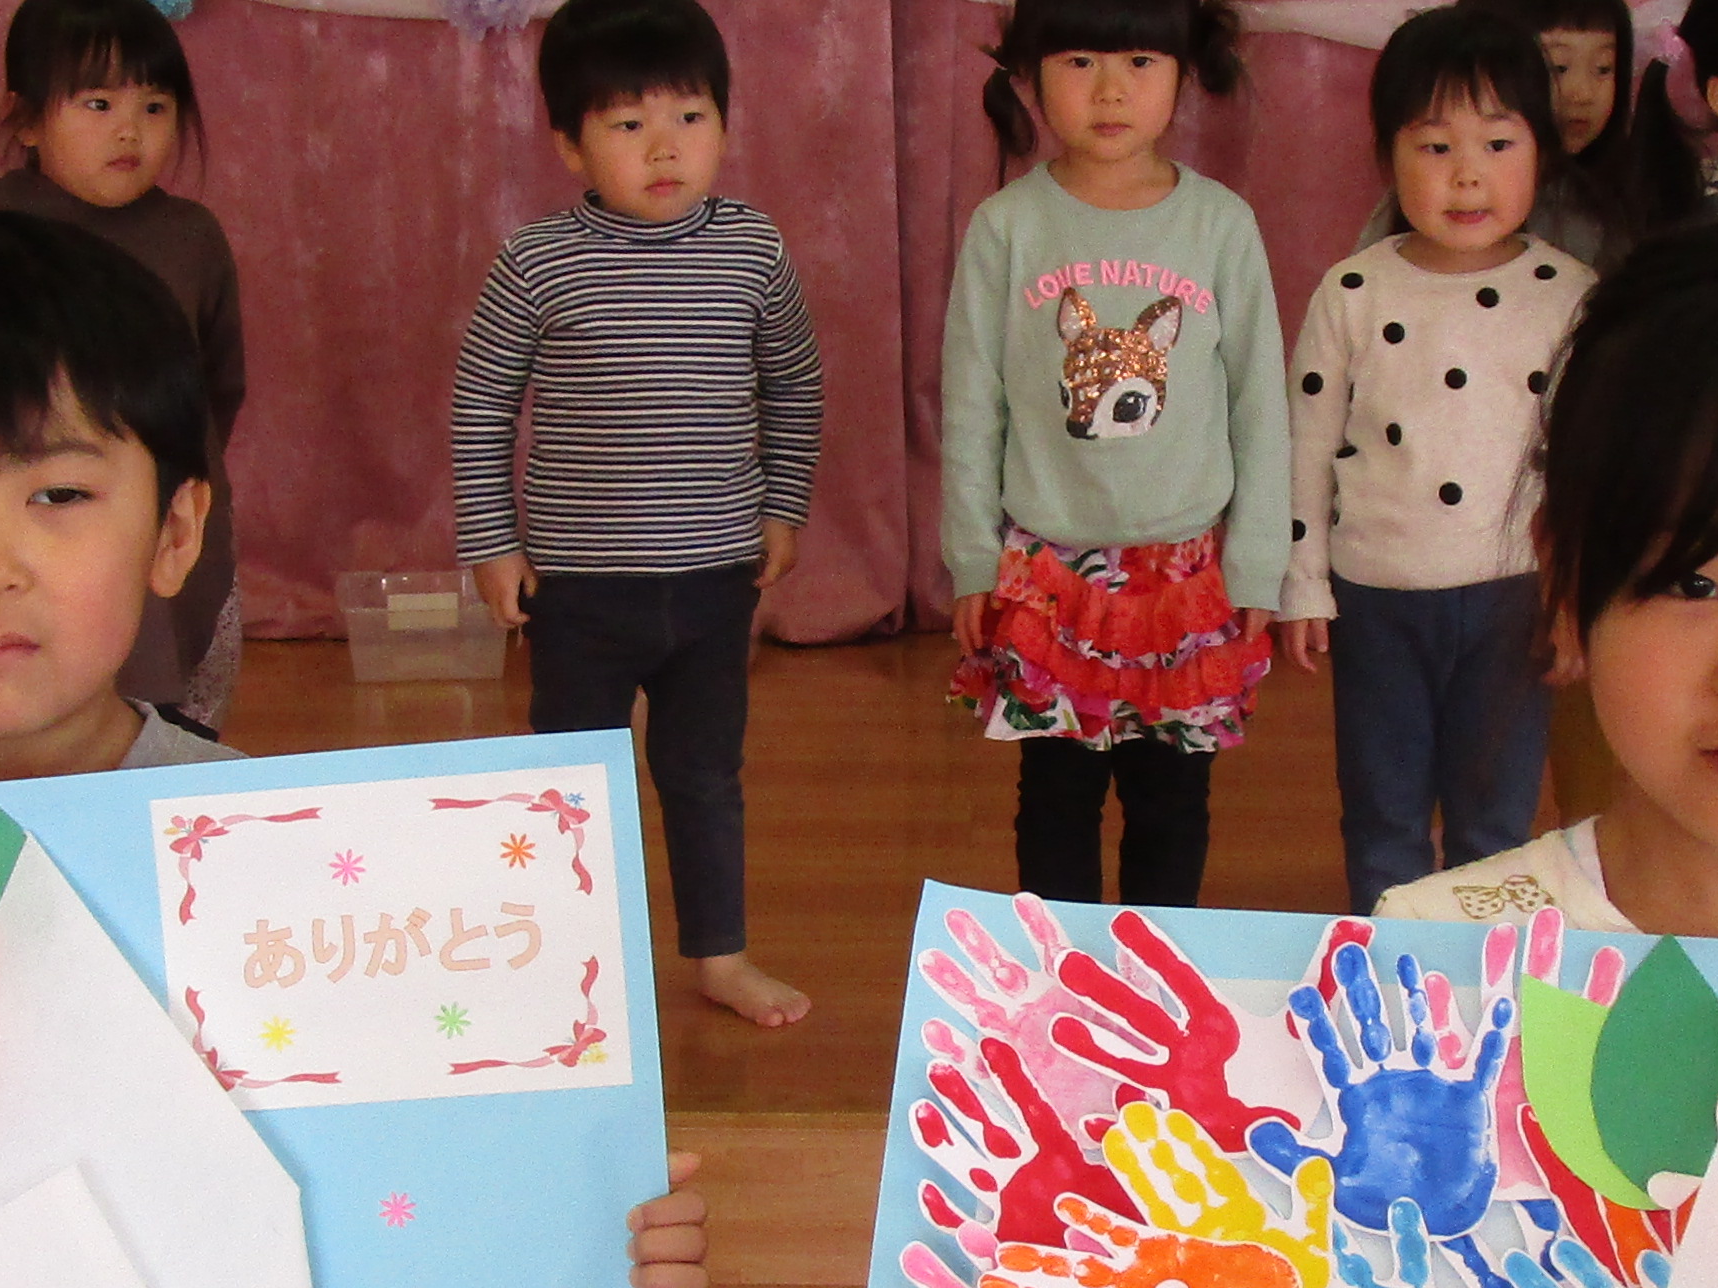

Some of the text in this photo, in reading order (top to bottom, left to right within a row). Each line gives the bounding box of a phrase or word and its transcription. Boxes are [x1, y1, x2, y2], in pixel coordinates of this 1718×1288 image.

[1023, 258, 1215, 315] LOVE NATURE
[243, 901, 543, 989] ありがとう
